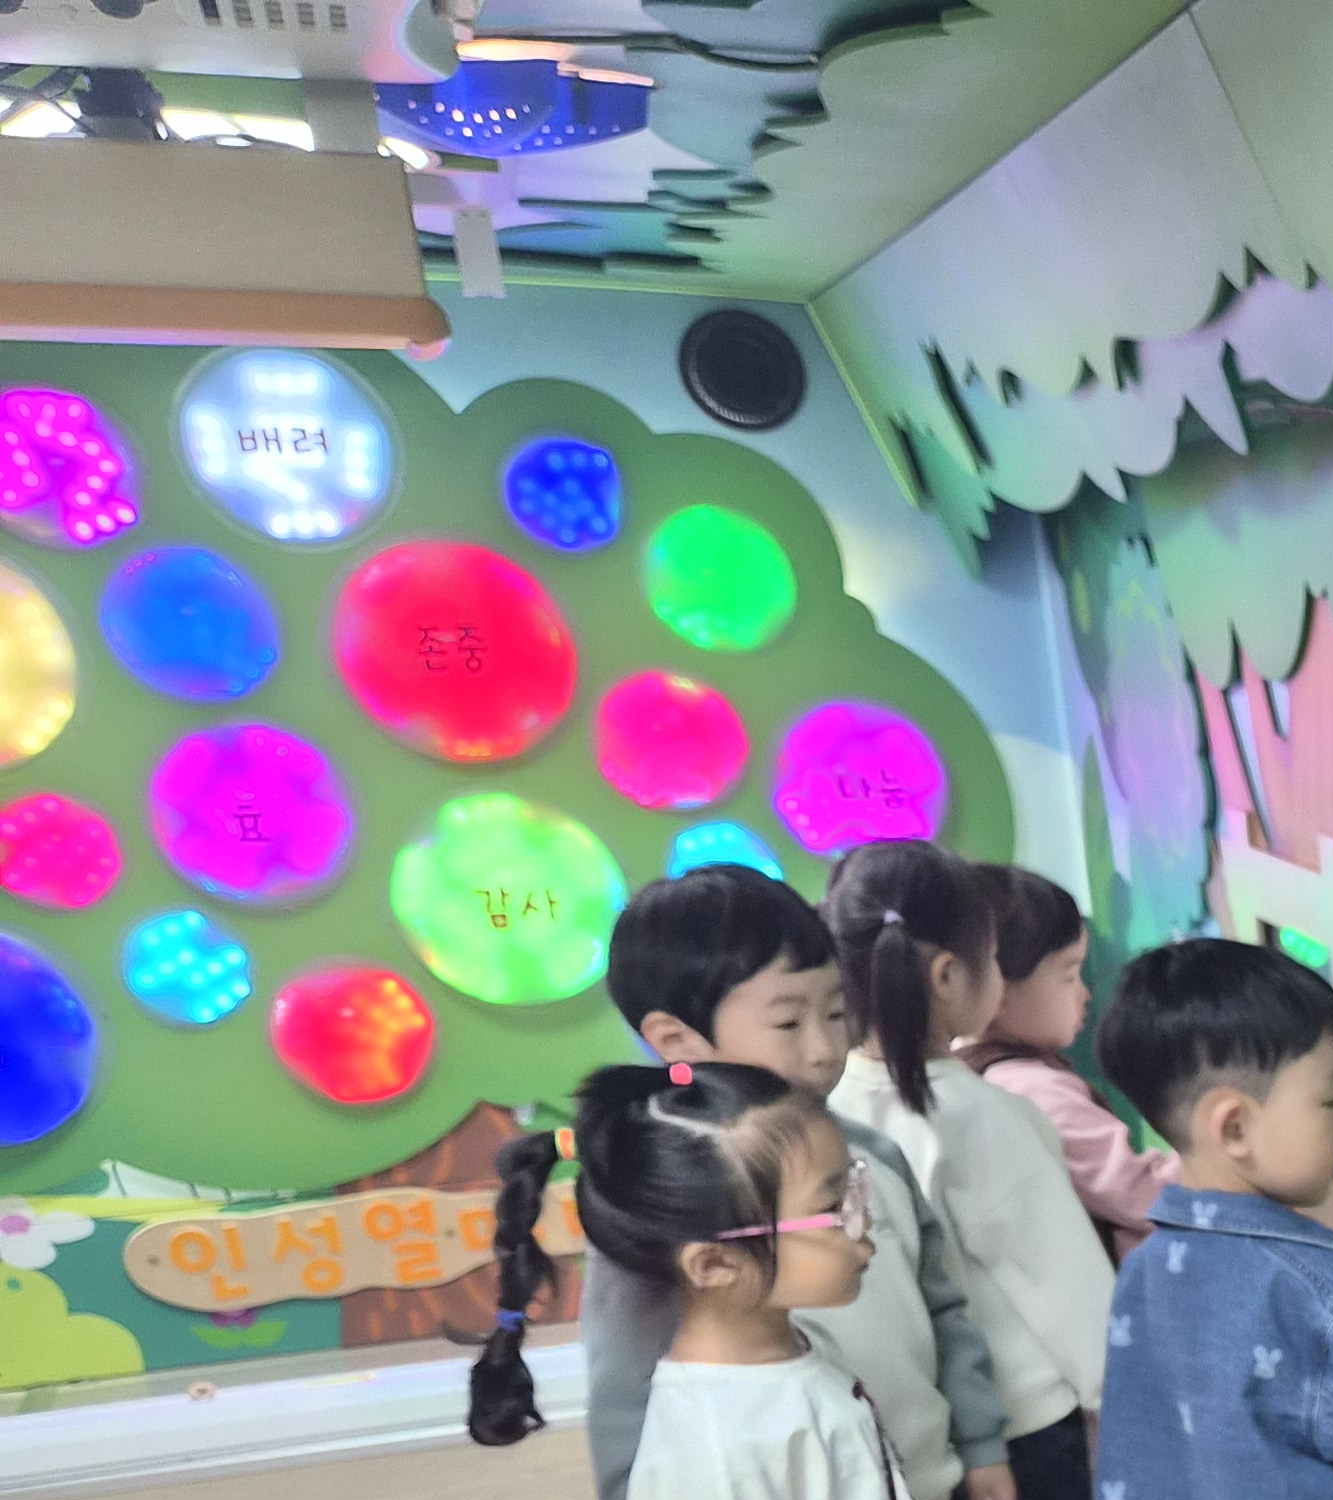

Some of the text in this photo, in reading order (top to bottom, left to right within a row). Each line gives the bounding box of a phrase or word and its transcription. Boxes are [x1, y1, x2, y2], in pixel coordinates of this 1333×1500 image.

[237, 427, 328, 454] 배려
[418, 625, 488, 671] 존중
[233, 804, 271, 841] 효
[476, 888, 557, 928] 감사
